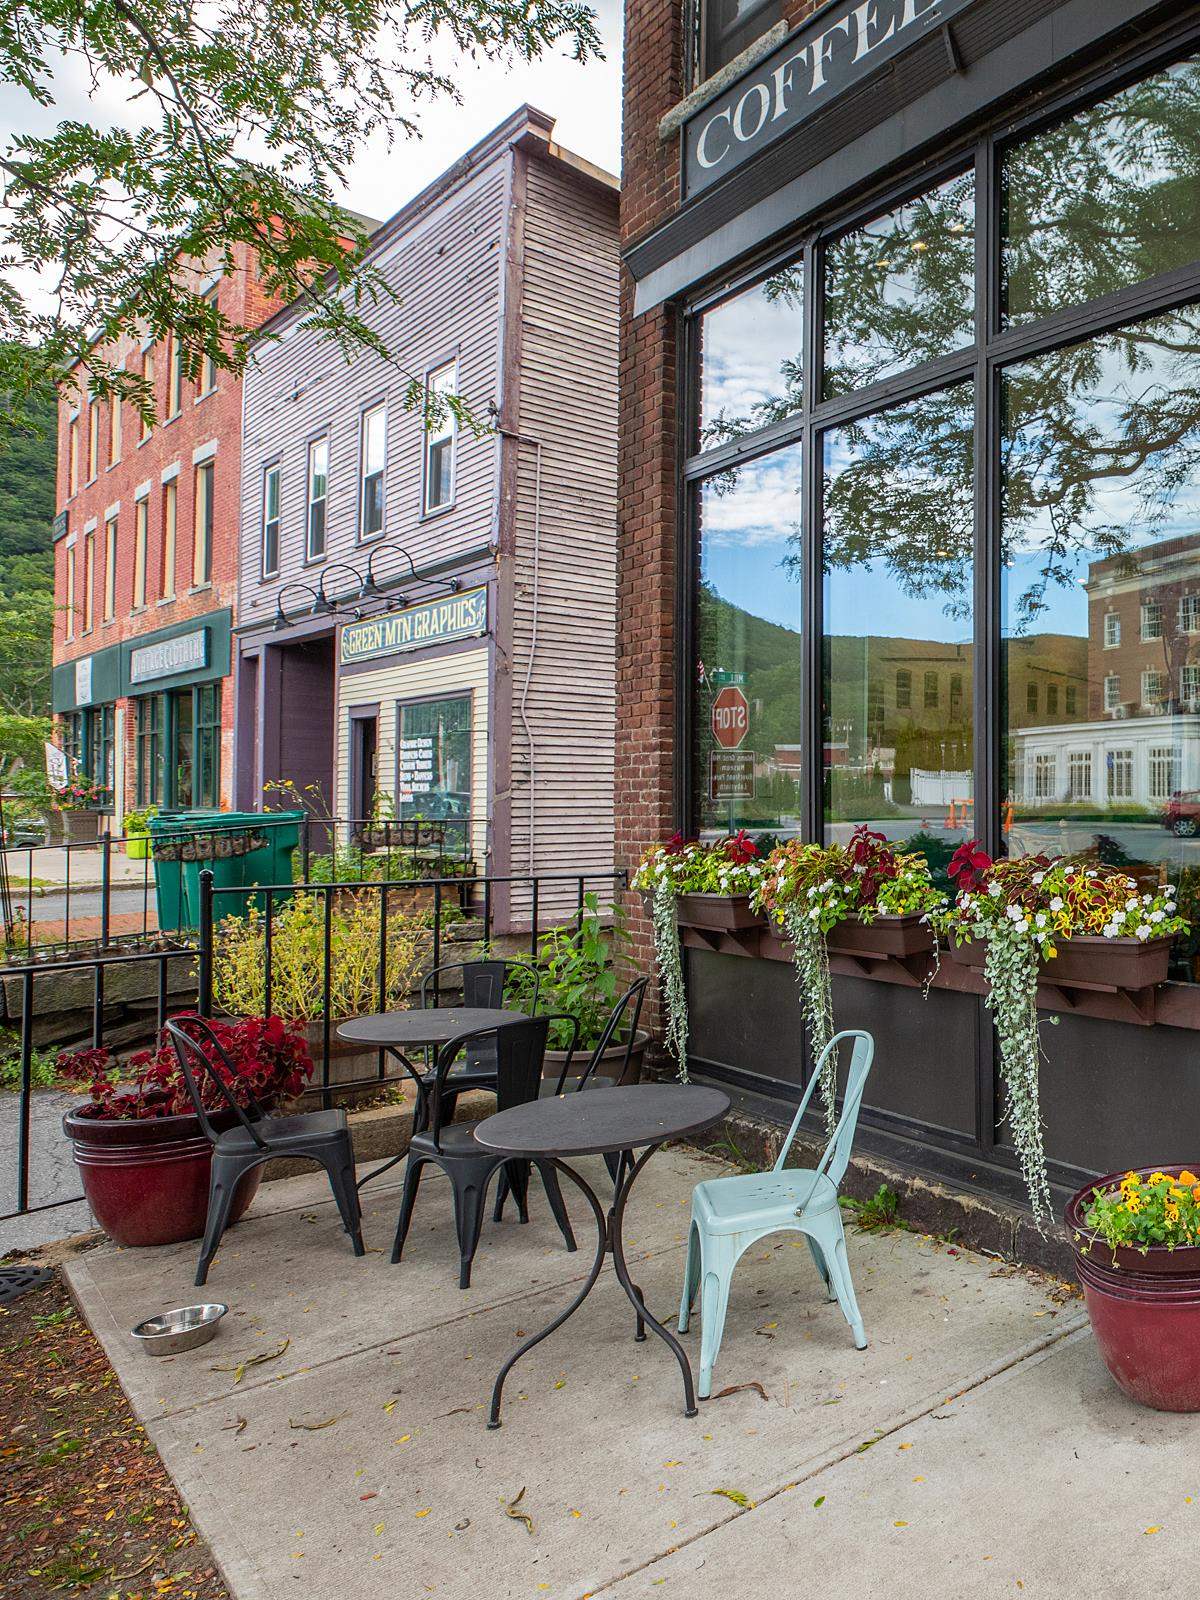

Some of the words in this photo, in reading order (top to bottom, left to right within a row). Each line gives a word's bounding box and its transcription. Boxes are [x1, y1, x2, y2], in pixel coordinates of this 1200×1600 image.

[349, 622, 383, 655] GREEN
[385, 615, 412, 647] MTN
[414, 598, 477, 640] GRAPHICS
